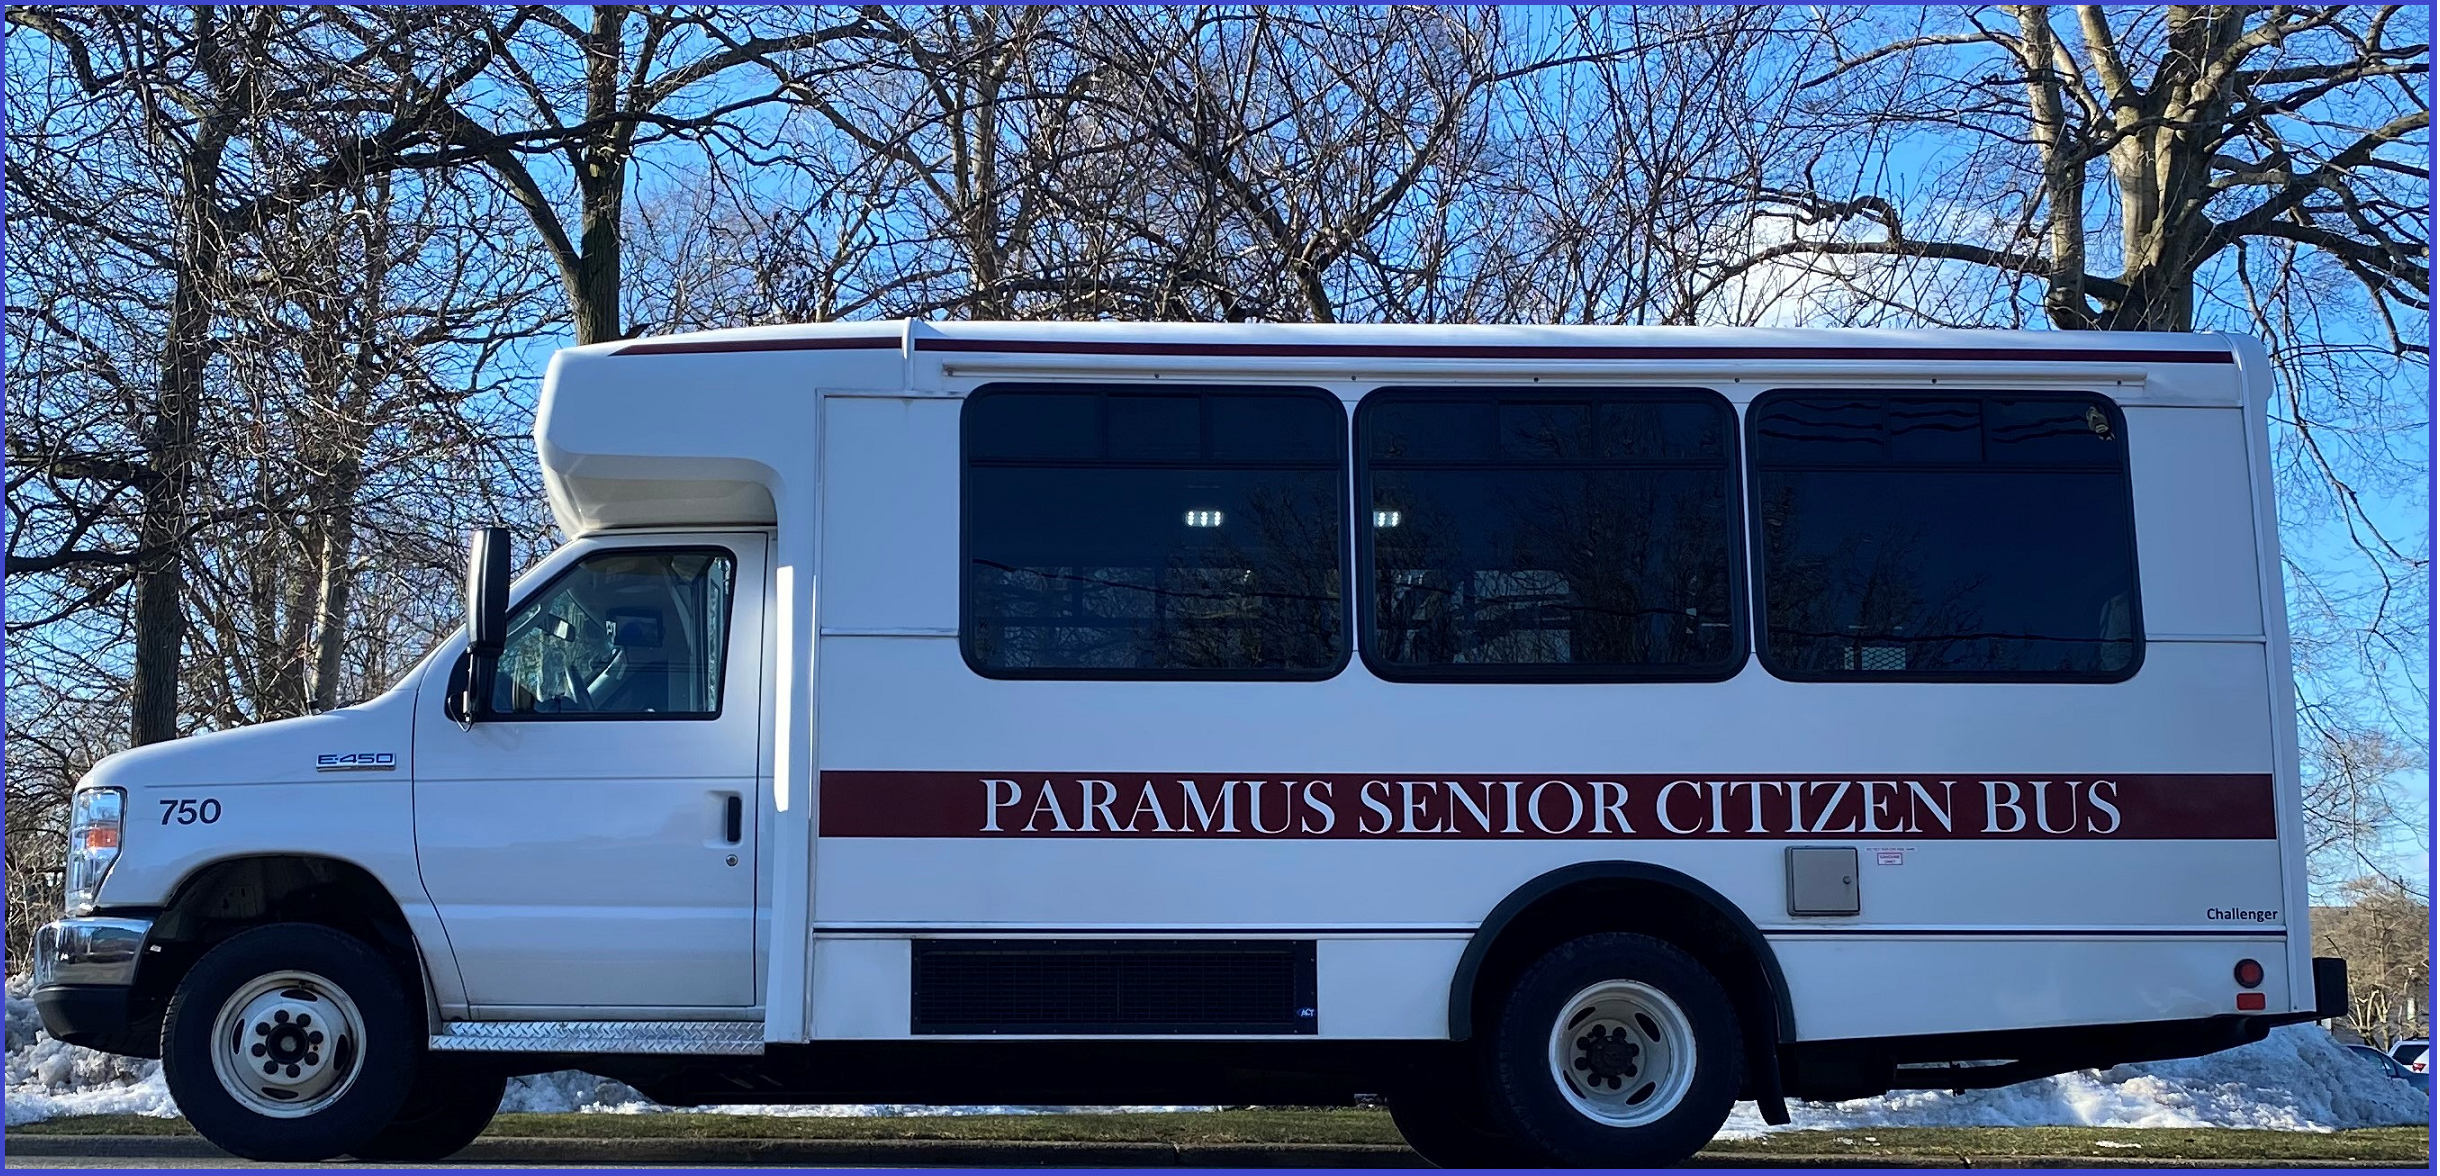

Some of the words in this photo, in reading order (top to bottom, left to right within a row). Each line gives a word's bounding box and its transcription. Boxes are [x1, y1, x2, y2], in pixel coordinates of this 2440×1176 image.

[317, 753, 394, 765] E-450
[159, 798, 221, 825] 750
[979, 779, 1335, 834] PARAMUS
[1359, 780, 1636, 834] SENIOR
[1656, 780, 1957, 834] CITIZEN
[1978, 780, 2121, 834] BUS
[2206, 907, 2279, 923] Challenger
